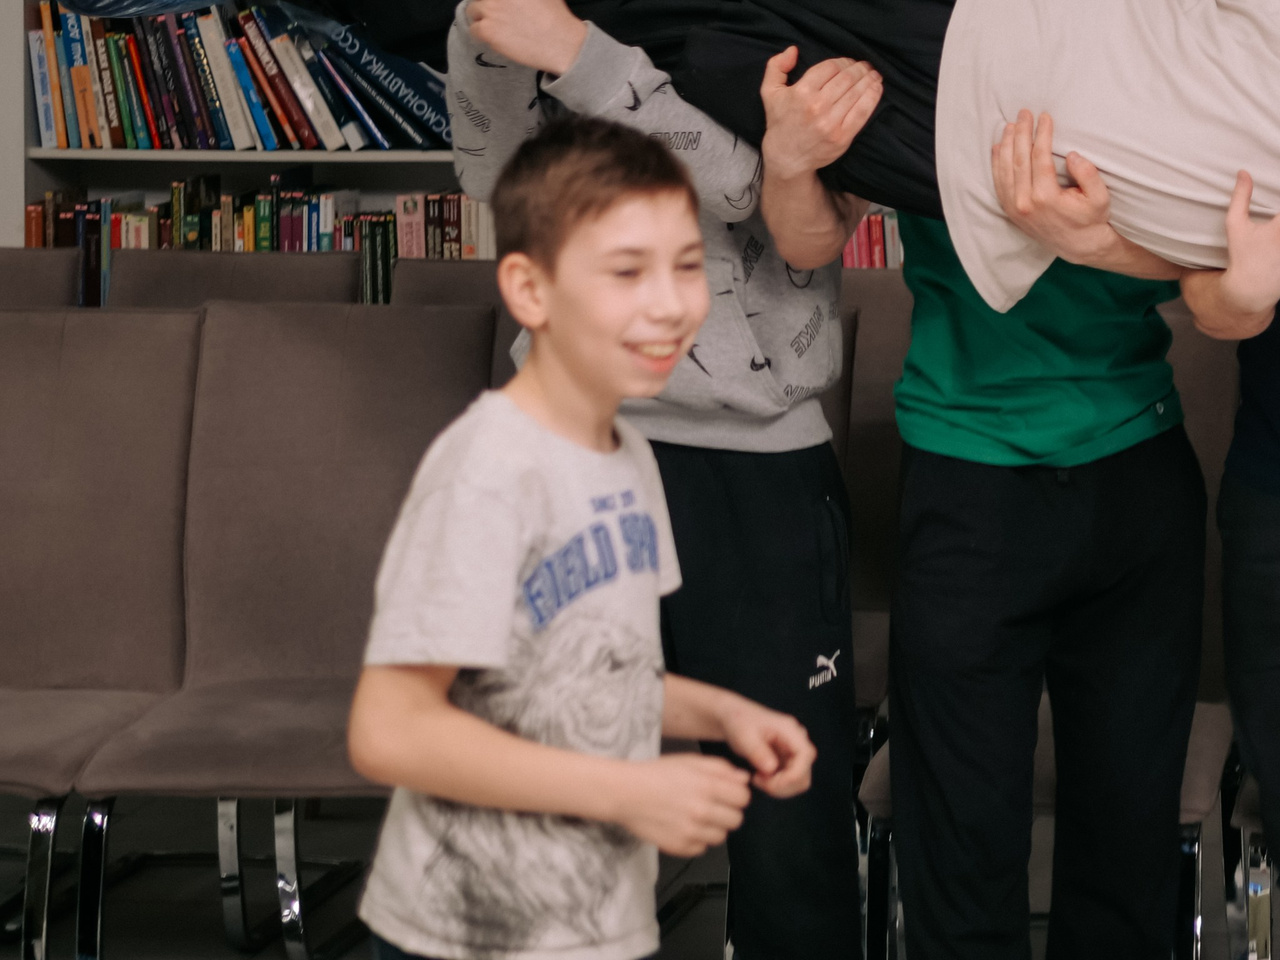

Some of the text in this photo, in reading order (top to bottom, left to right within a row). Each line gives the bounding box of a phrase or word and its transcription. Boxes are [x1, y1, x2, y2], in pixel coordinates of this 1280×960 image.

[360, 49, 453, 143] ОСМОНАВТИКА
[743, 235, 765, 284] IKE
[790, 305, 825, 359] NIKE
